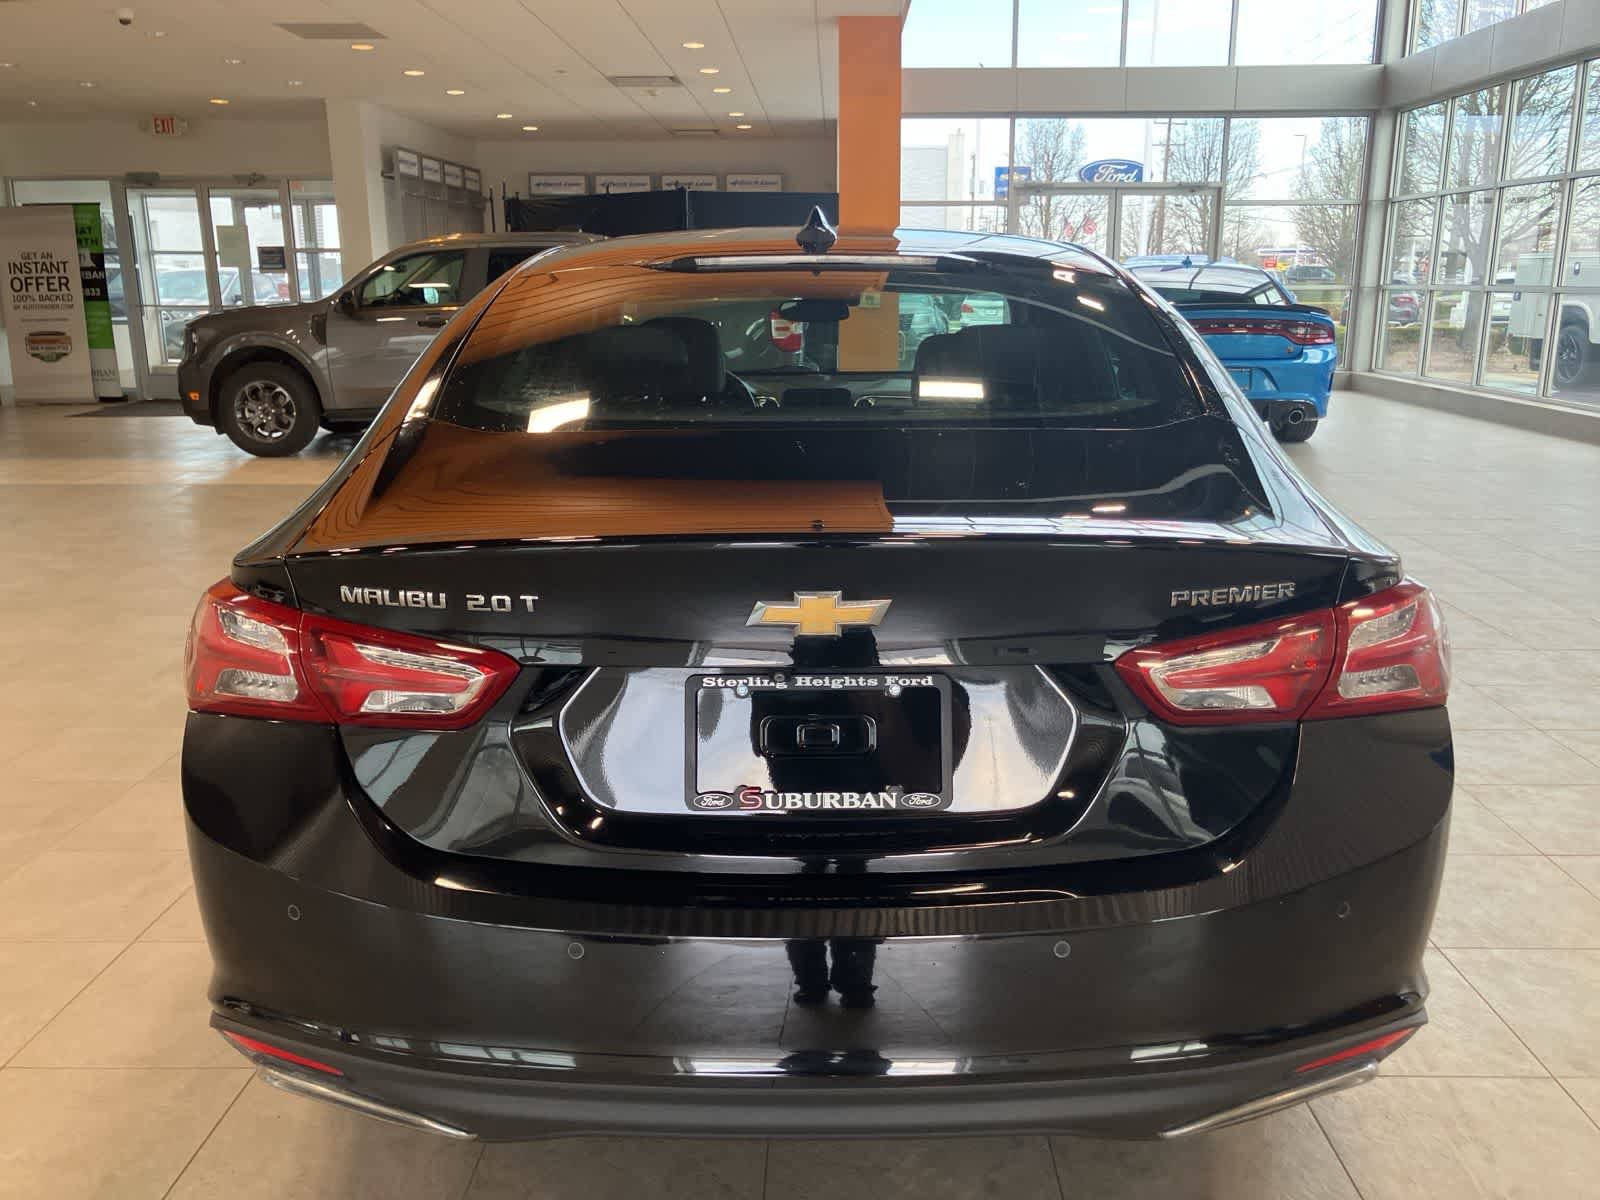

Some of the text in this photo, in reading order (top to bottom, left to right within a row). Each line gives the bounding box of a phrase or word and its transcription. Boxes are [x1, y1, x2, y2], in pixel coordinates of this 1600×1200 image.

[153, 117, 175, 135] EXIT
[21, 251, 53, 260] GET AN
[8, 261, 69, 275] INSTANT
[10, 276, 71, 293] OFFER
[12, 294, 73, 303] 100% BACKED
[339, 584, 447, 609] MALIBU
[1170, 582, 1296, 608] PREMIER
[795, 676, 879, 688] Heights
[884, 675, 934, 687] Ford
[739, 787, 898, 810] SUBURBAN
